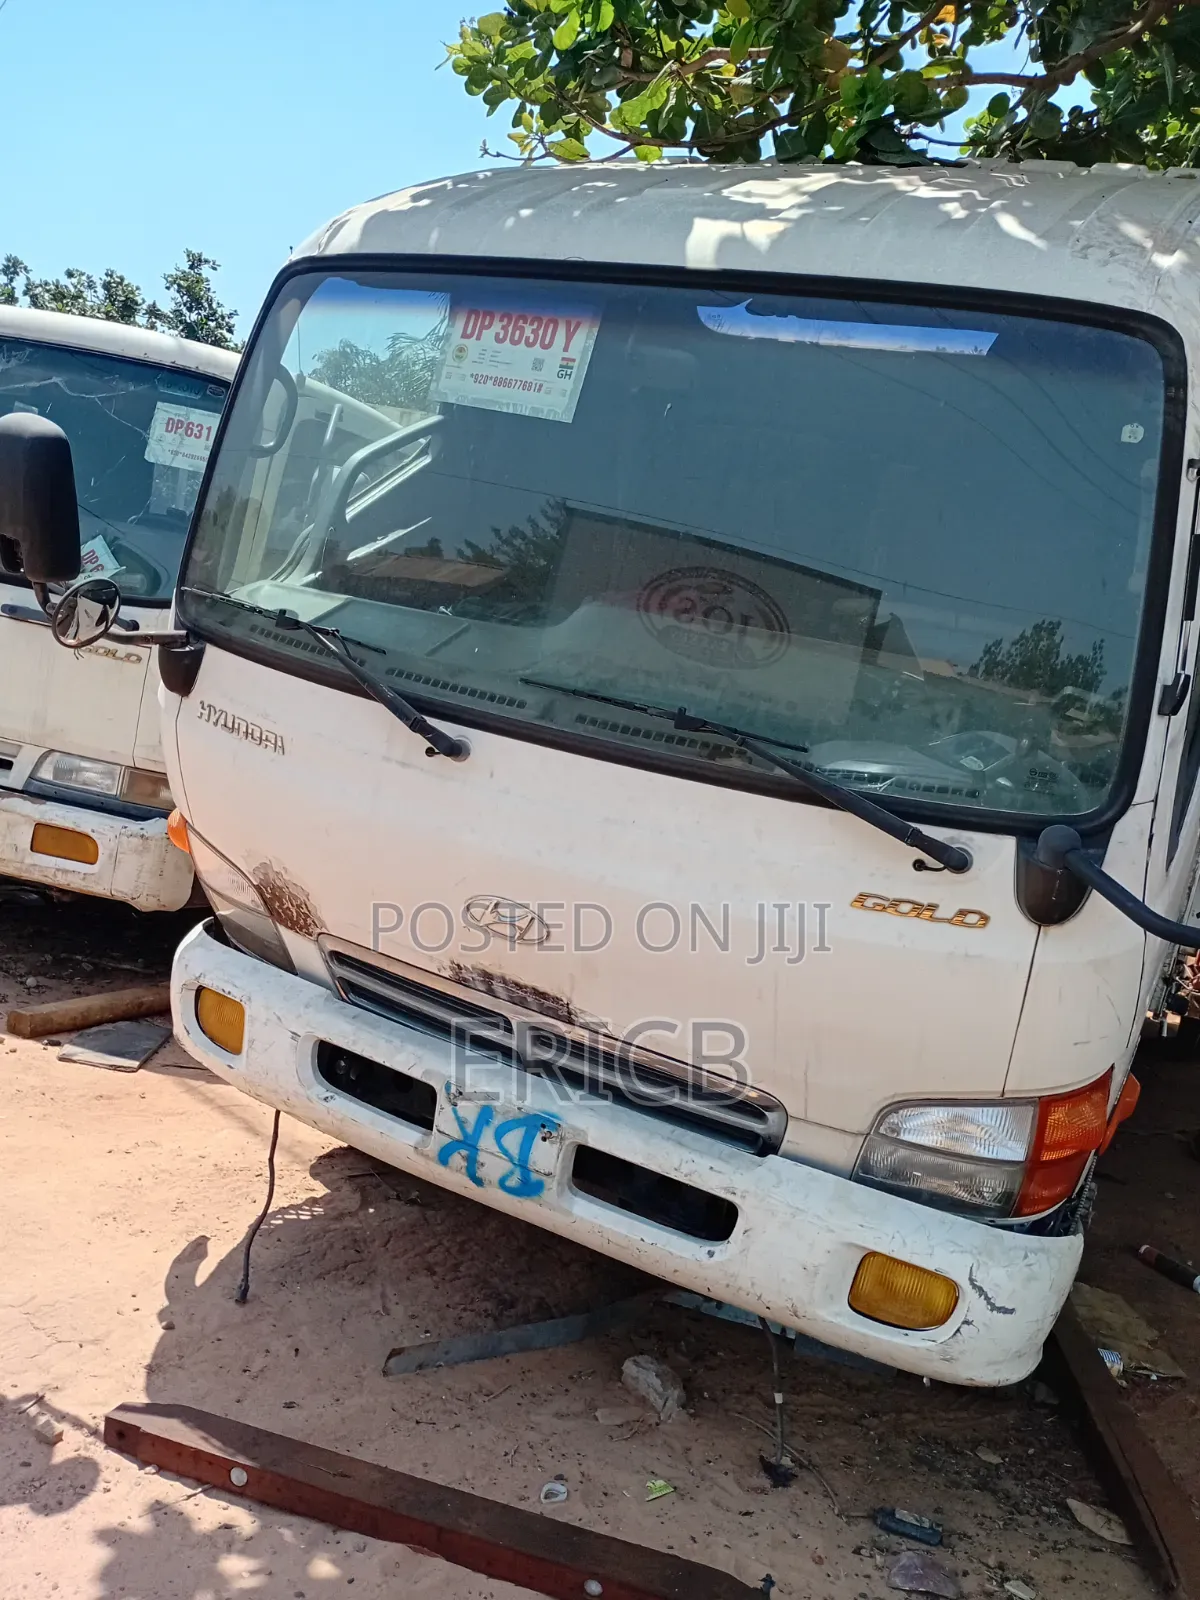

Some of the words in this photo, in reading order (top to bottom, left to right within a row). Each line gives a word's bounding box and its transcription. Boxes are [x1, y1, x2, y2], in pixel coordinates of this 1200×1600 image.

[460, 308, 496, 341] DP
[494, 312, 560, 350] 3630
[562, 319, 582, 353] Y
[556, 369, 573, 381] GH
[164, 416, 185, 435] DP
[197, 700, 285, 756] HYUNDAI
[850, 892, 991, 928] GOLD
